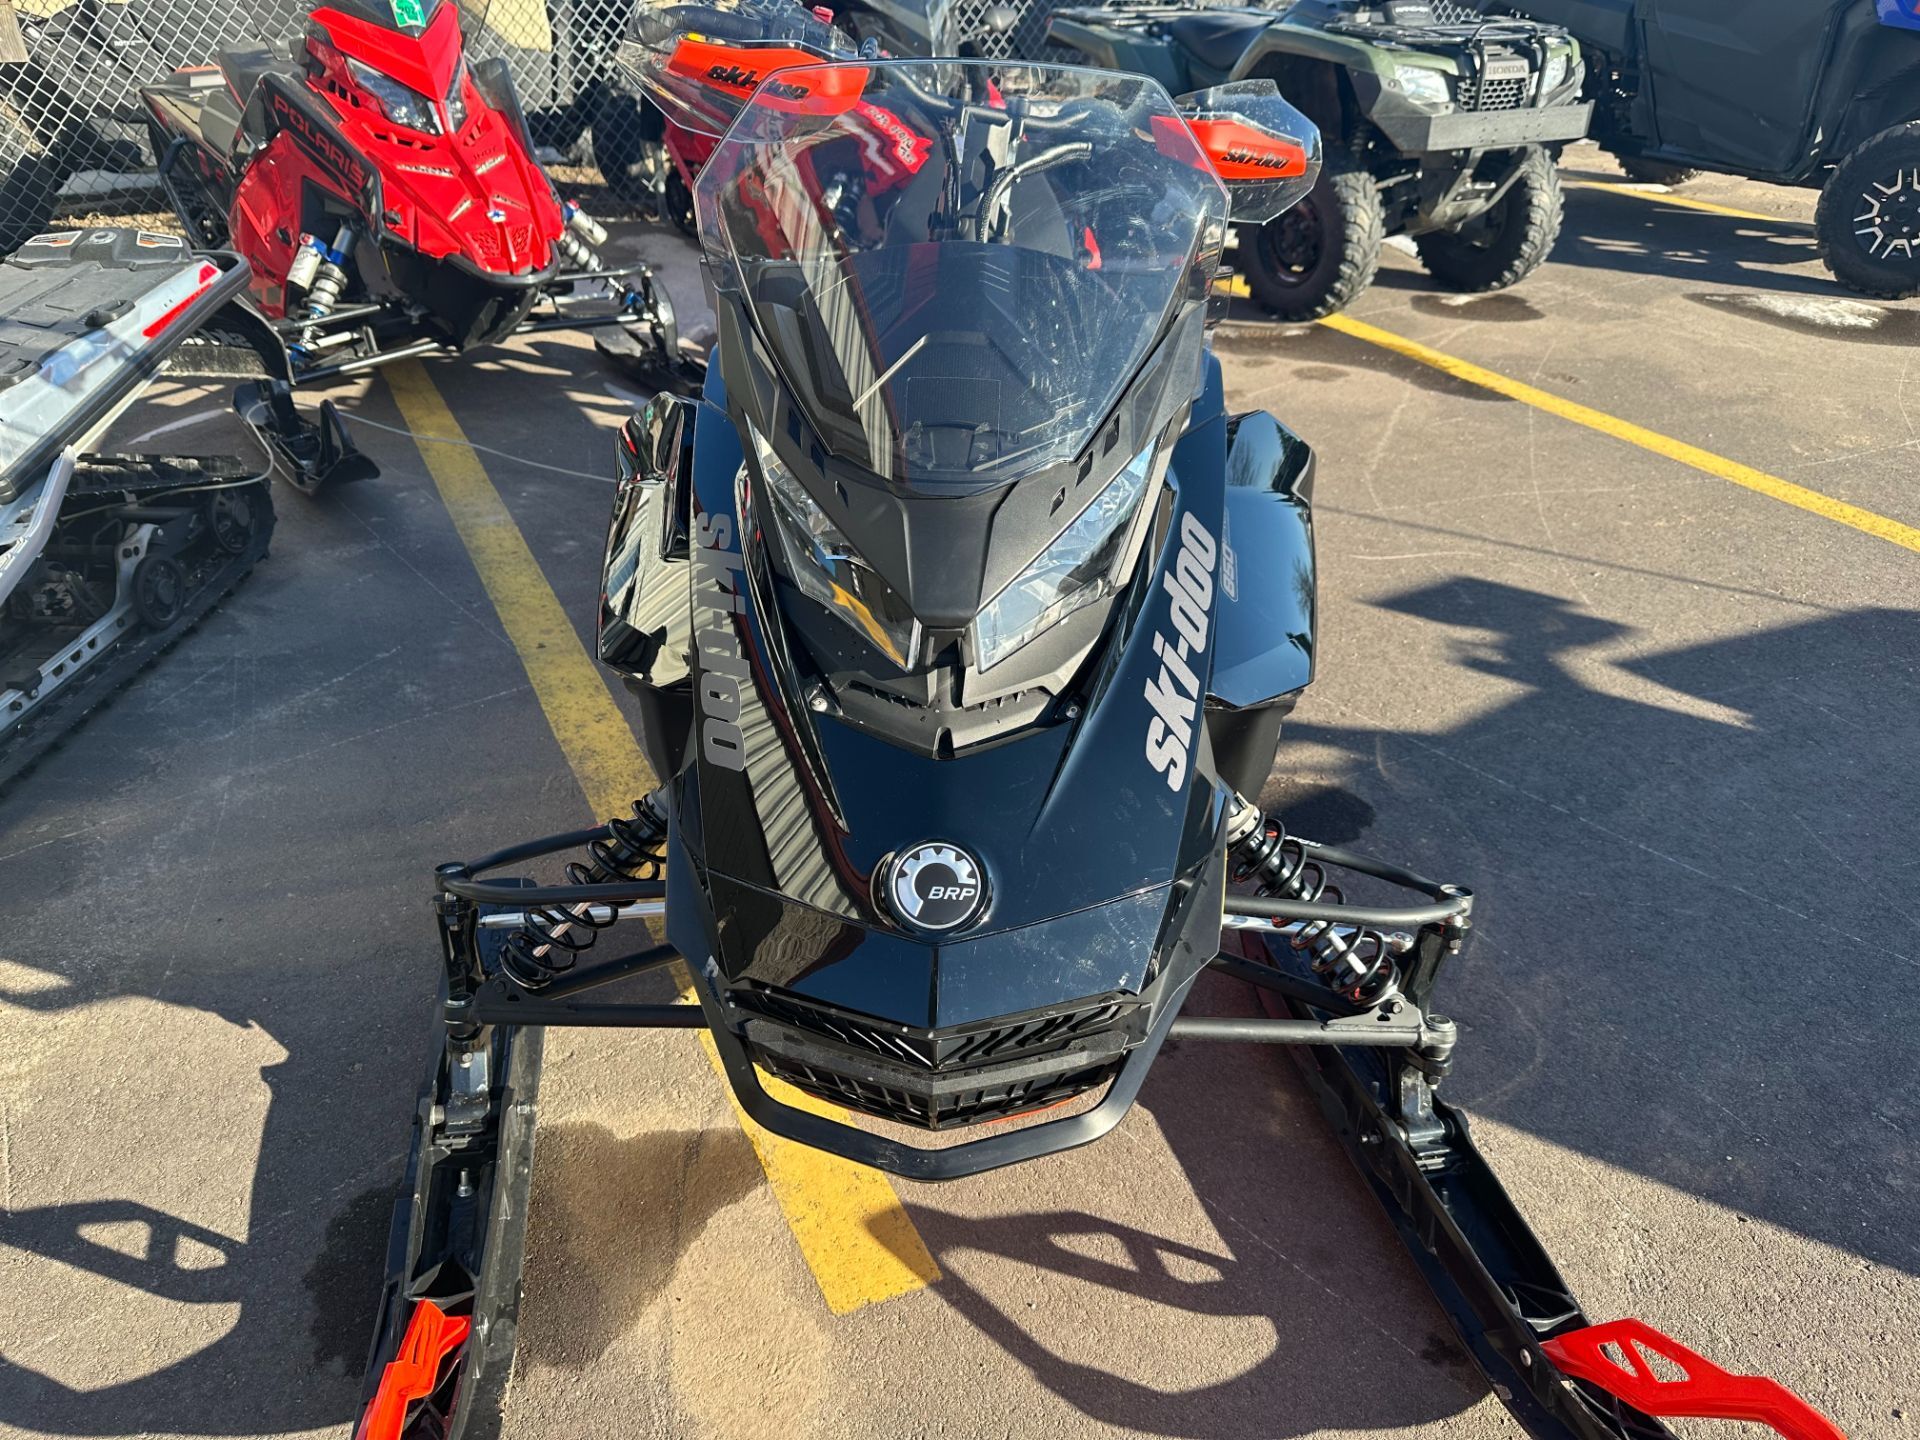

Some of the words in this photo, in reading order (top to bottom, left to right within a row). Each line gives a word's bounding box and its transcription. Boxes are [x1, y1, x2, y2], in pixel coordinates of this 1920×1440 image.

[1488, 65, 1526, 75] HONDA
[274, 95, 365, 188] POLARIS
[1222, 542, 1235, 598] 850
[1144, 511, 1216, 792] ski-doo
[928, 886, 975, 900] BRP
